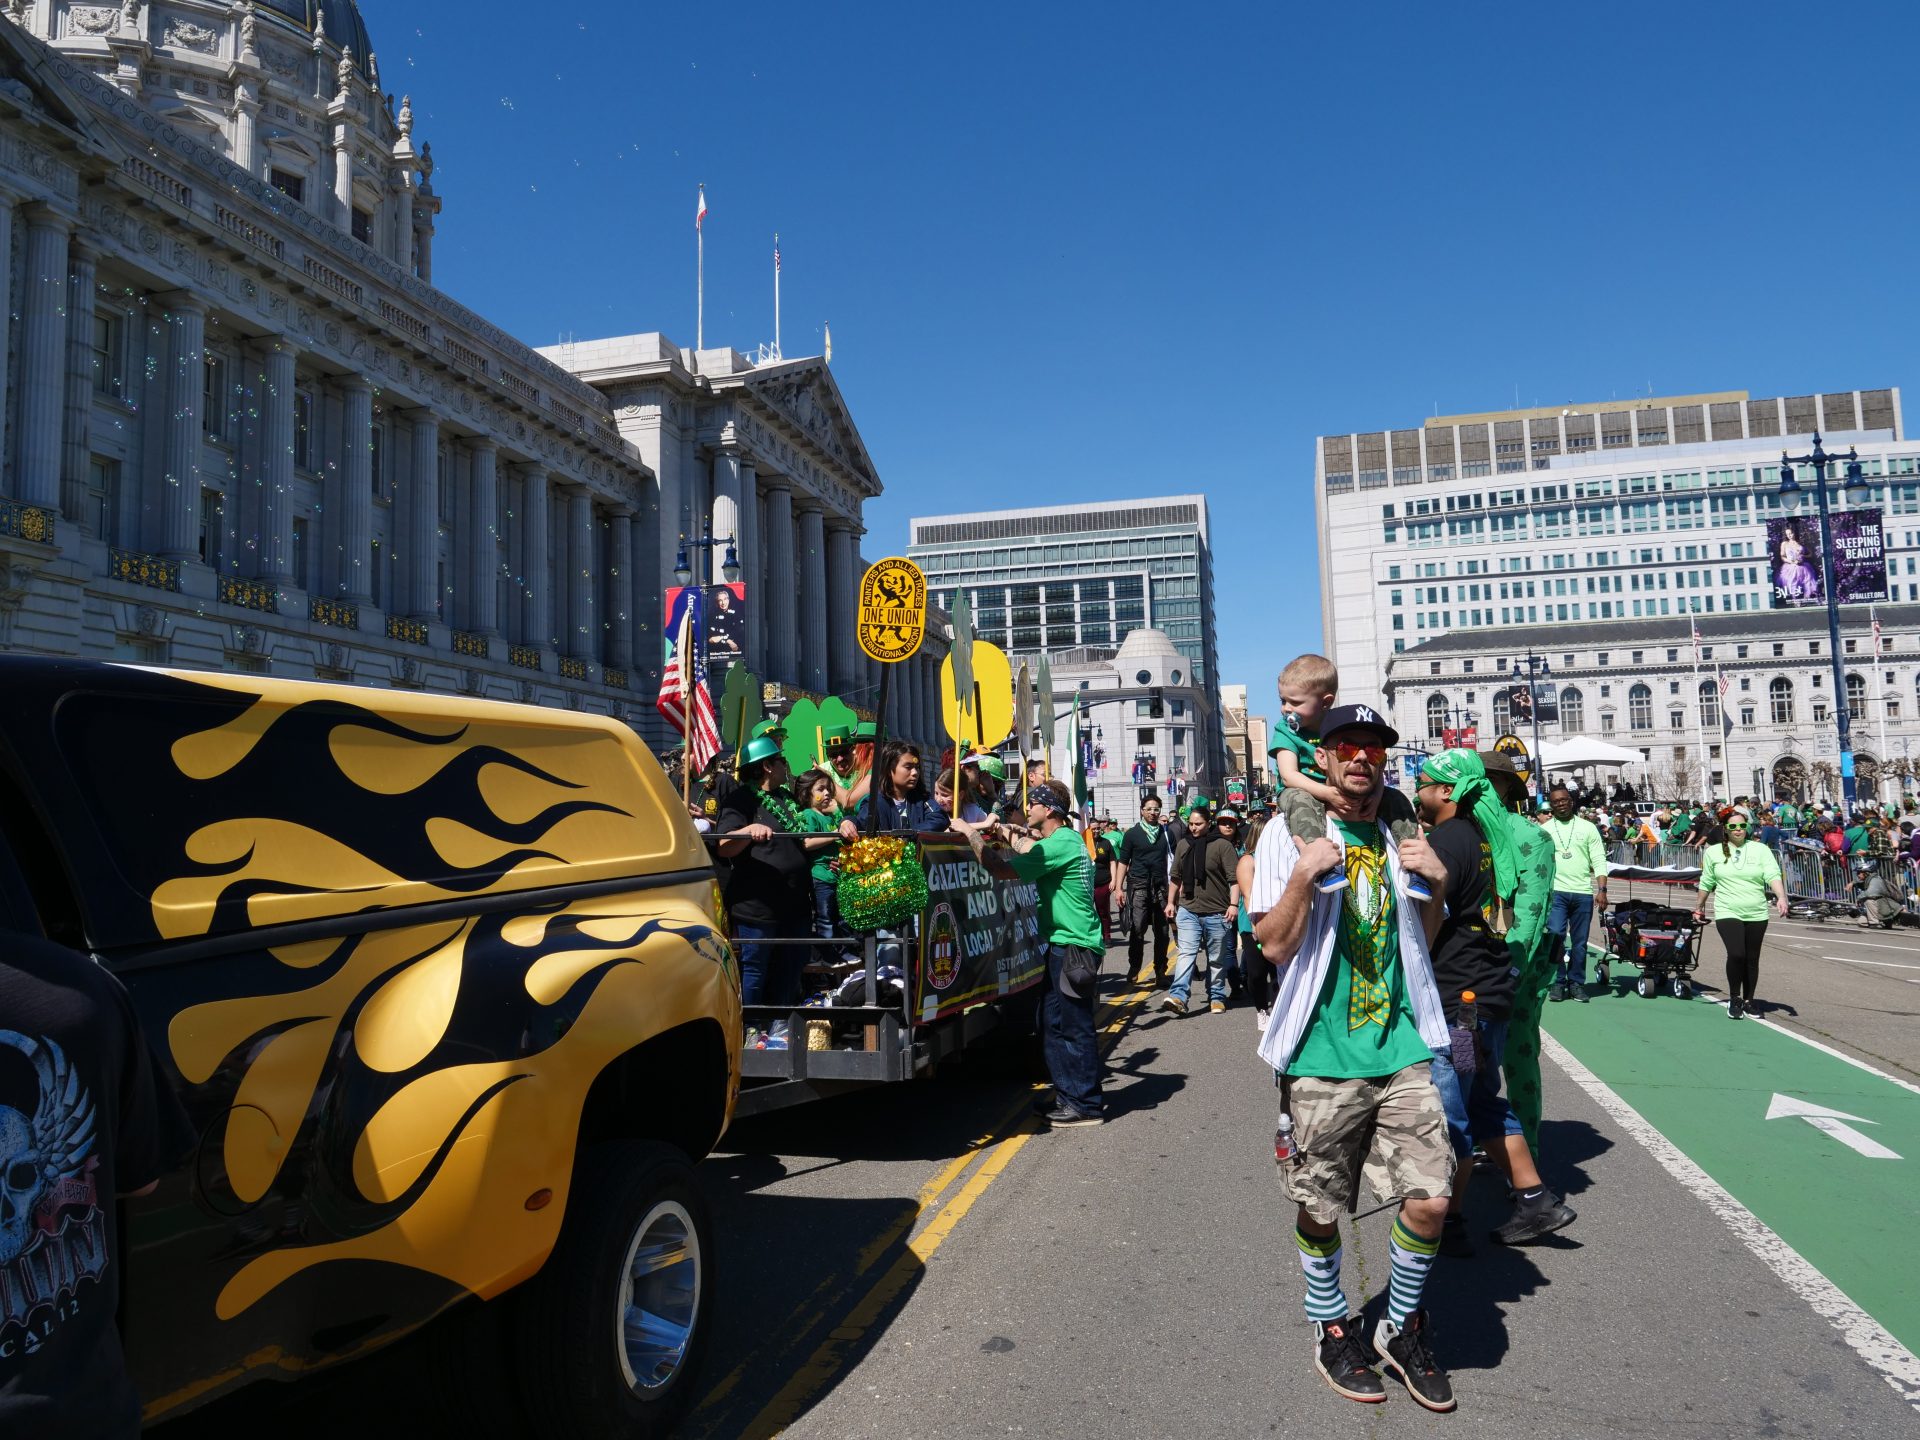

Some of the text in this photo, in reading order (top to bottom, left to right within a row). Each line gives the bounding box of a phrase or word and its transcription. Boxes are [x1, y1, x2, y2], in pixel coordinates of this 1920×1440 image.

[1861, 525, 1879, 536] THE
[1836, 536, 1880, 549] SLEEPING
[1846, 547, 1881, 559] BEAUTY
[864, 561, 923, 607] PAINTERS AND ALLIED TRADES
[864, 608, 919, 625] ONE UNION
[861, 625, 919, 659] INTERNATIONAL UNION
[1356, 706, 1373, 722] NY
[967, 890, 997, 920] AND
[963, 929, 994, 958] LOCAL
[0, 1318, 54, 1358] CAL
